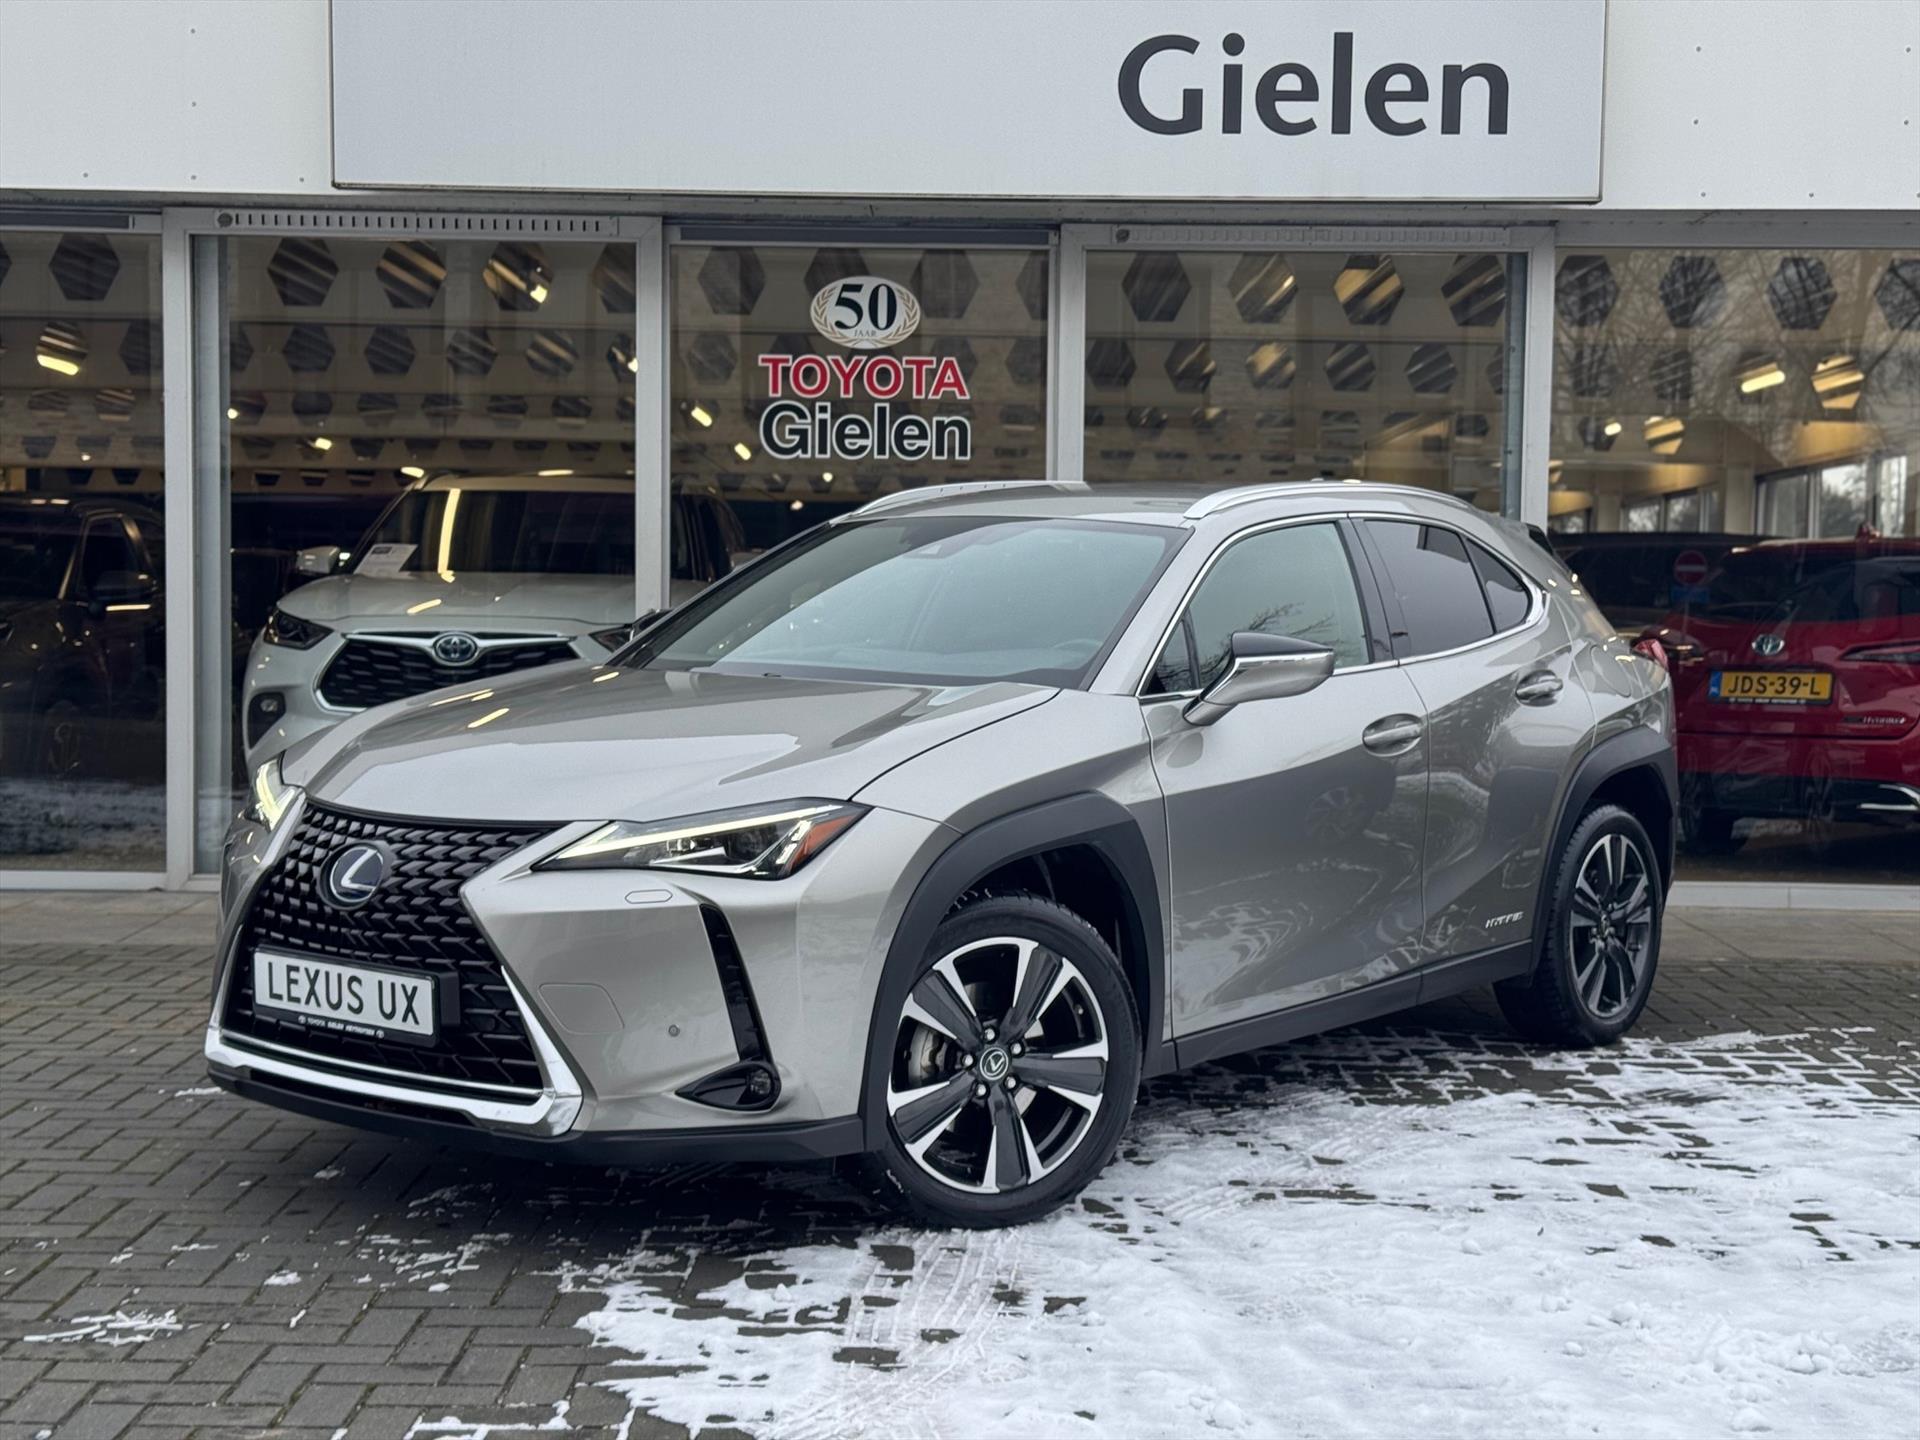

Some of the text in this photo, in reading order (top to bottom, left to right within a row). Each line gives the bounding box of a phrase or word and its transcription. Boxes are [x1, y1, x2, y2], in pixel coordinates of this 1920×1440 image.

[1118, 32, 1509, 136] Gielen
[834, 283, 898, 331] 50
[854, 329, 877, 337] JAAR
[759, 355, 970, 399] TOYOTA
[760, 401, 971, 460] Gielen
[1727, 675, 1822, 696] JDS-39-L
[268, 961, 420, 1026] LEXUS UX
